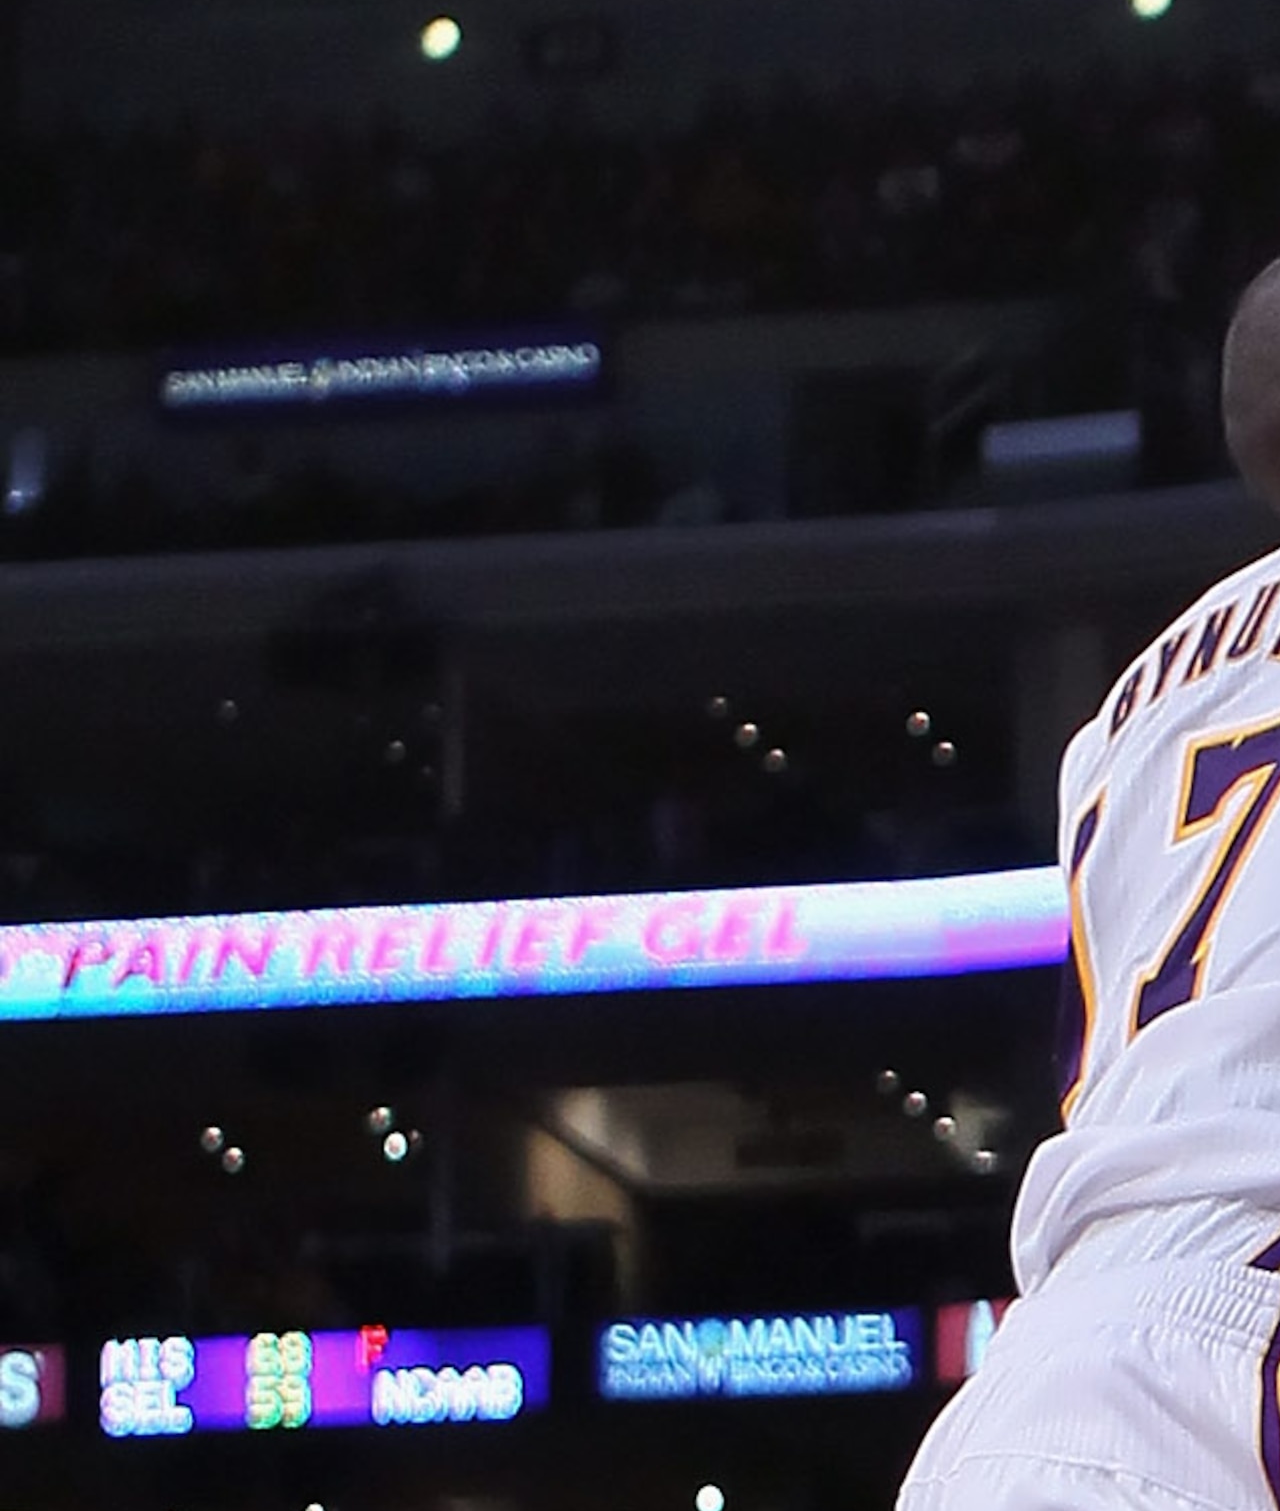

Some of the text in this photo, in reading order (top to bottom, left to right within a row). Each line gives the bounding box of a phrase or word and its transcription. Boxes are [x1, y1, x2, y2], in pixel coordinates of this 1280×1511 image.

[62, 892, 810, 990] PAIN RELIEF GEL
[606, 1313, 908, 1362] SAN MANUEL
